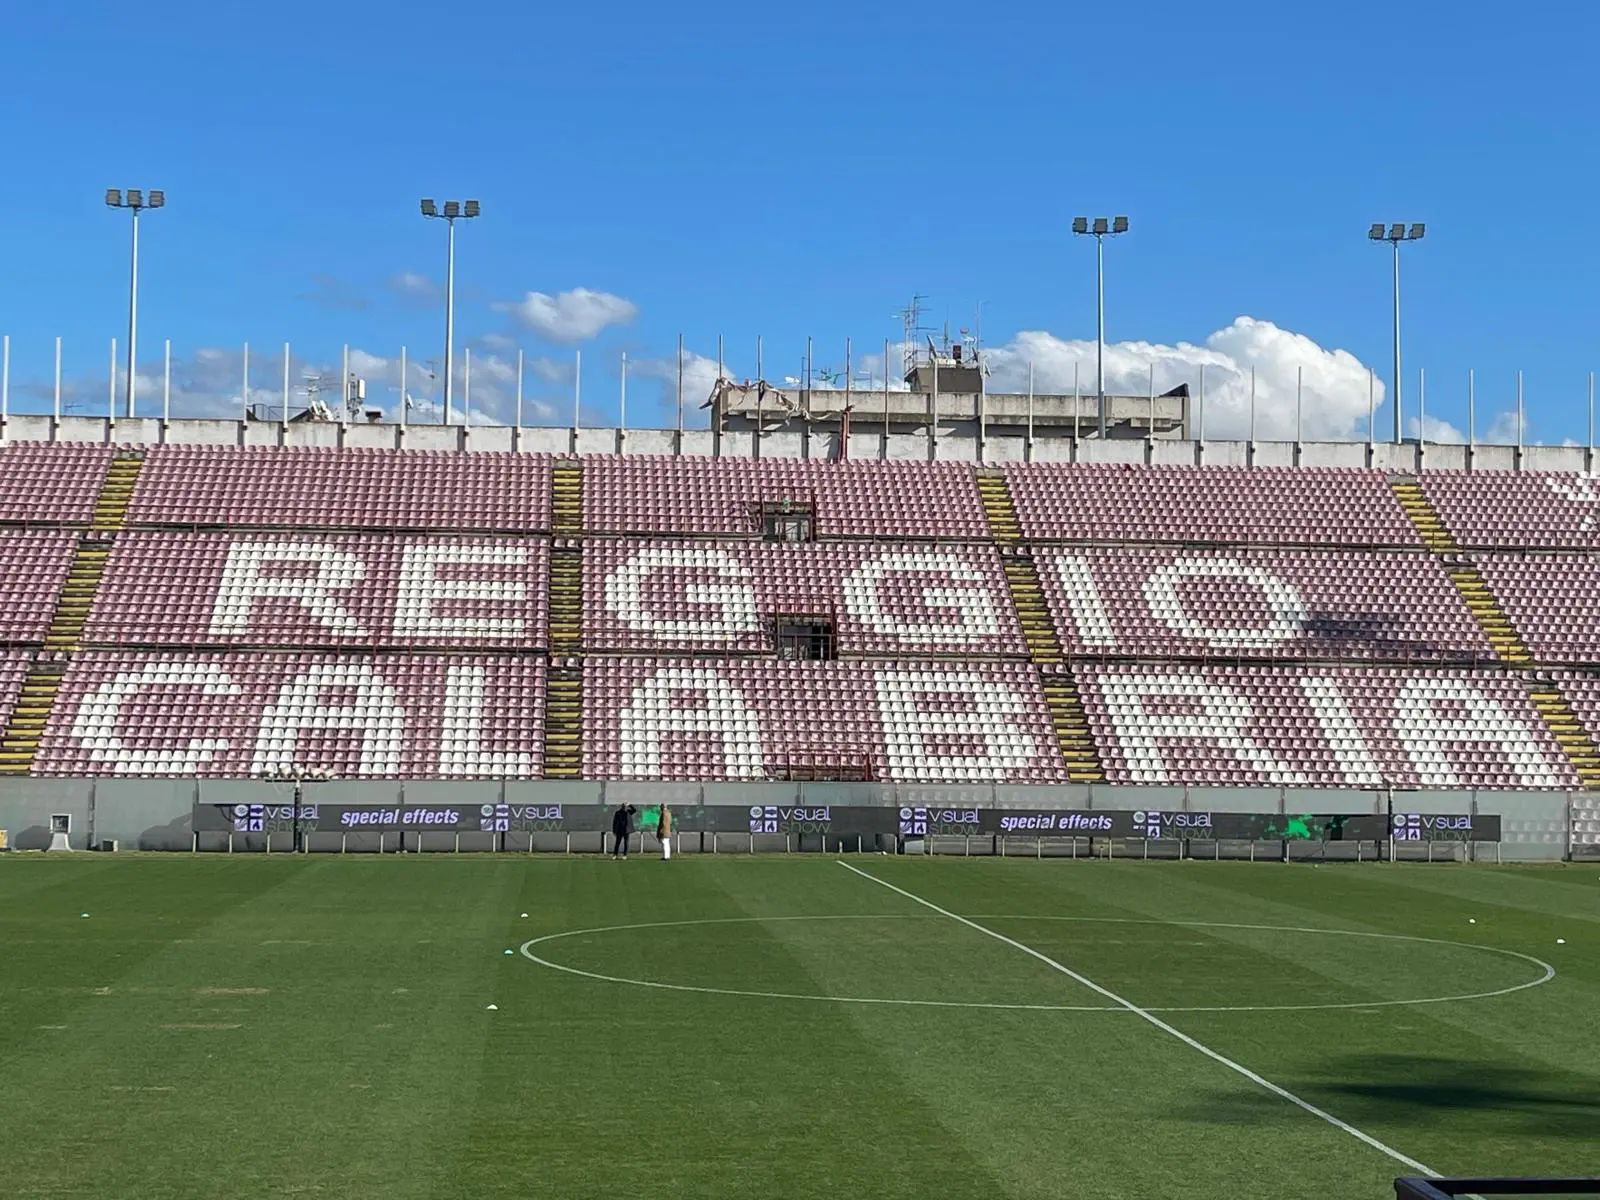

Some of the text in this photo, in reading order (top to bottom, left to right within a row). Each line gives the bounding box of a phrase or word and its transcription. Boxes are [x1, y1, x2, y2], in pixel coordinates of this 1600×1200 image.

[208, 541, 1310, 648] REGGIO
[70, 662, 1561, 785] CALABRIA
[340, 809, 460, 827] special effects
[1000, 814, 1113, 832] special effects
